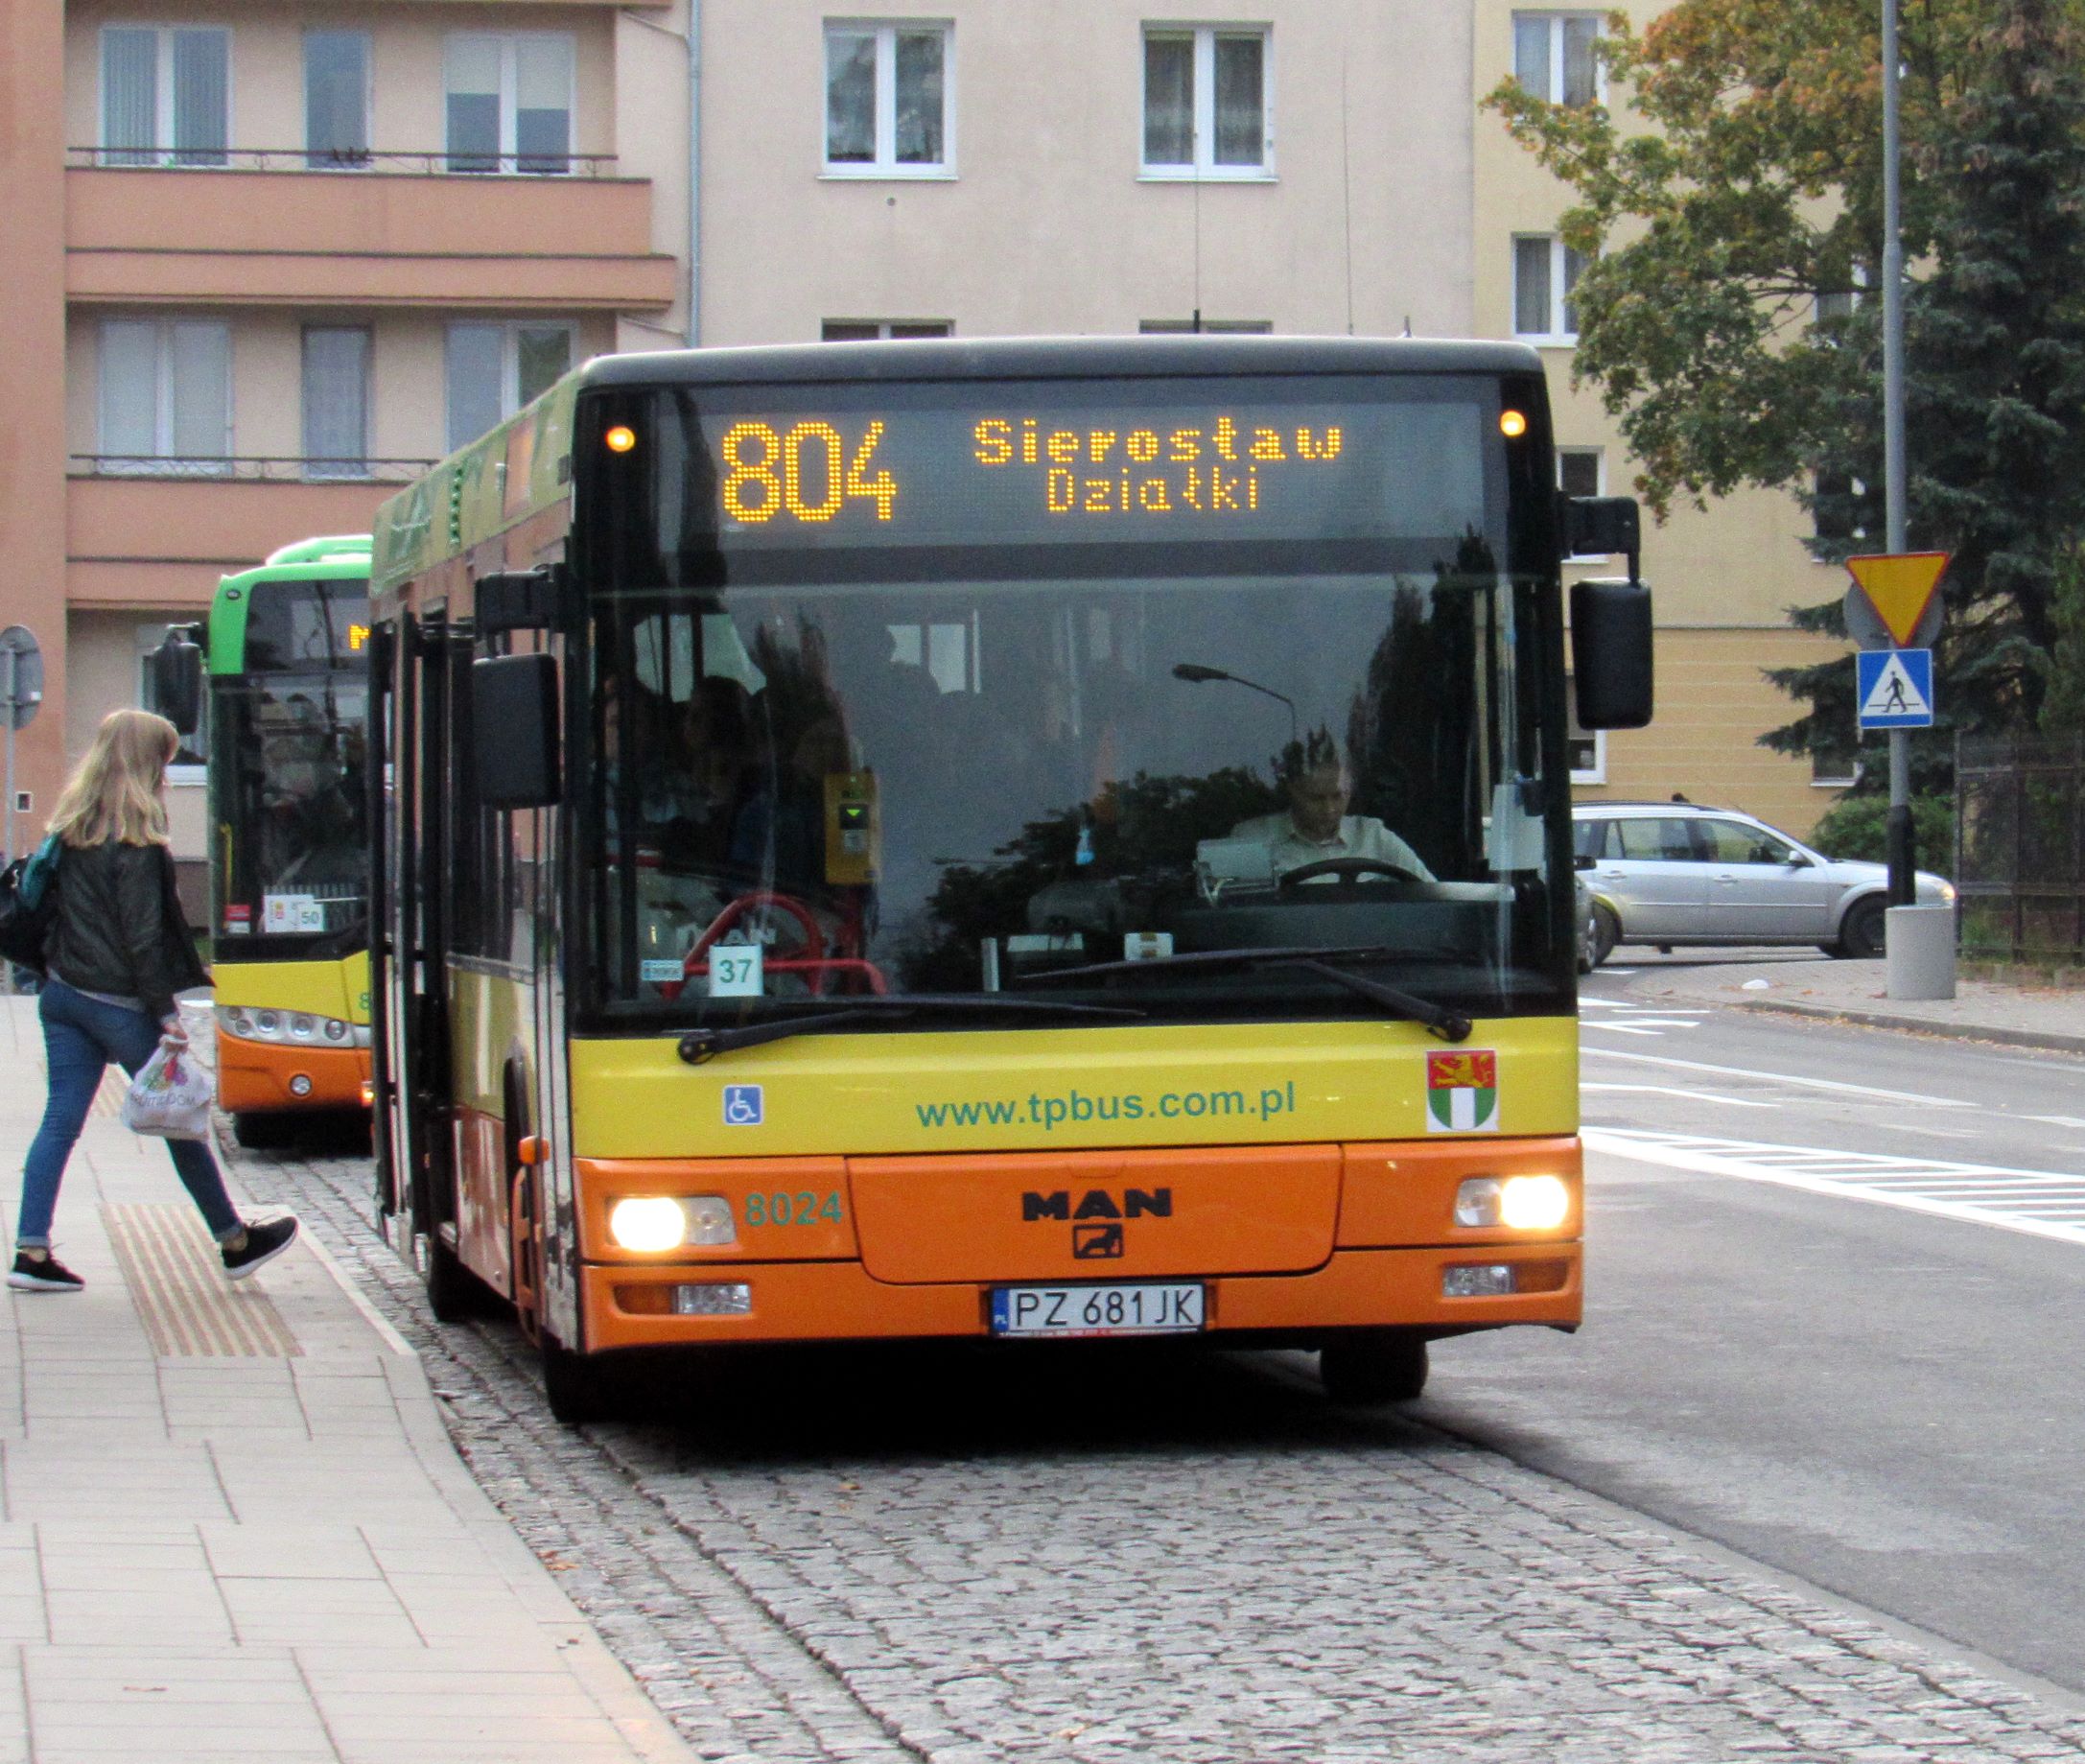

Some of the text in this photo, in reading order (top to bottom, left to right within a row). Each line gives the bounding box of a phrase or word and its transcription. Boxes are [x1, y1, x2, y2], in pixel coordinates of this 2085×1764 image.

[974, 417, 1342, 463] Sierosław
[723, 421, 897, 523] 804
[1047, 466, 1259, 511] Działki
[719, 959, 752, 983] 37
[916, 1081, 1295, 1130] www.tpbus.com.pl
[745, 1190, 843, 1226] 8024
[1022, 1188, 1172, 1220] MAN
[1017, 1289, 1195, 1327] PZ 681JK
